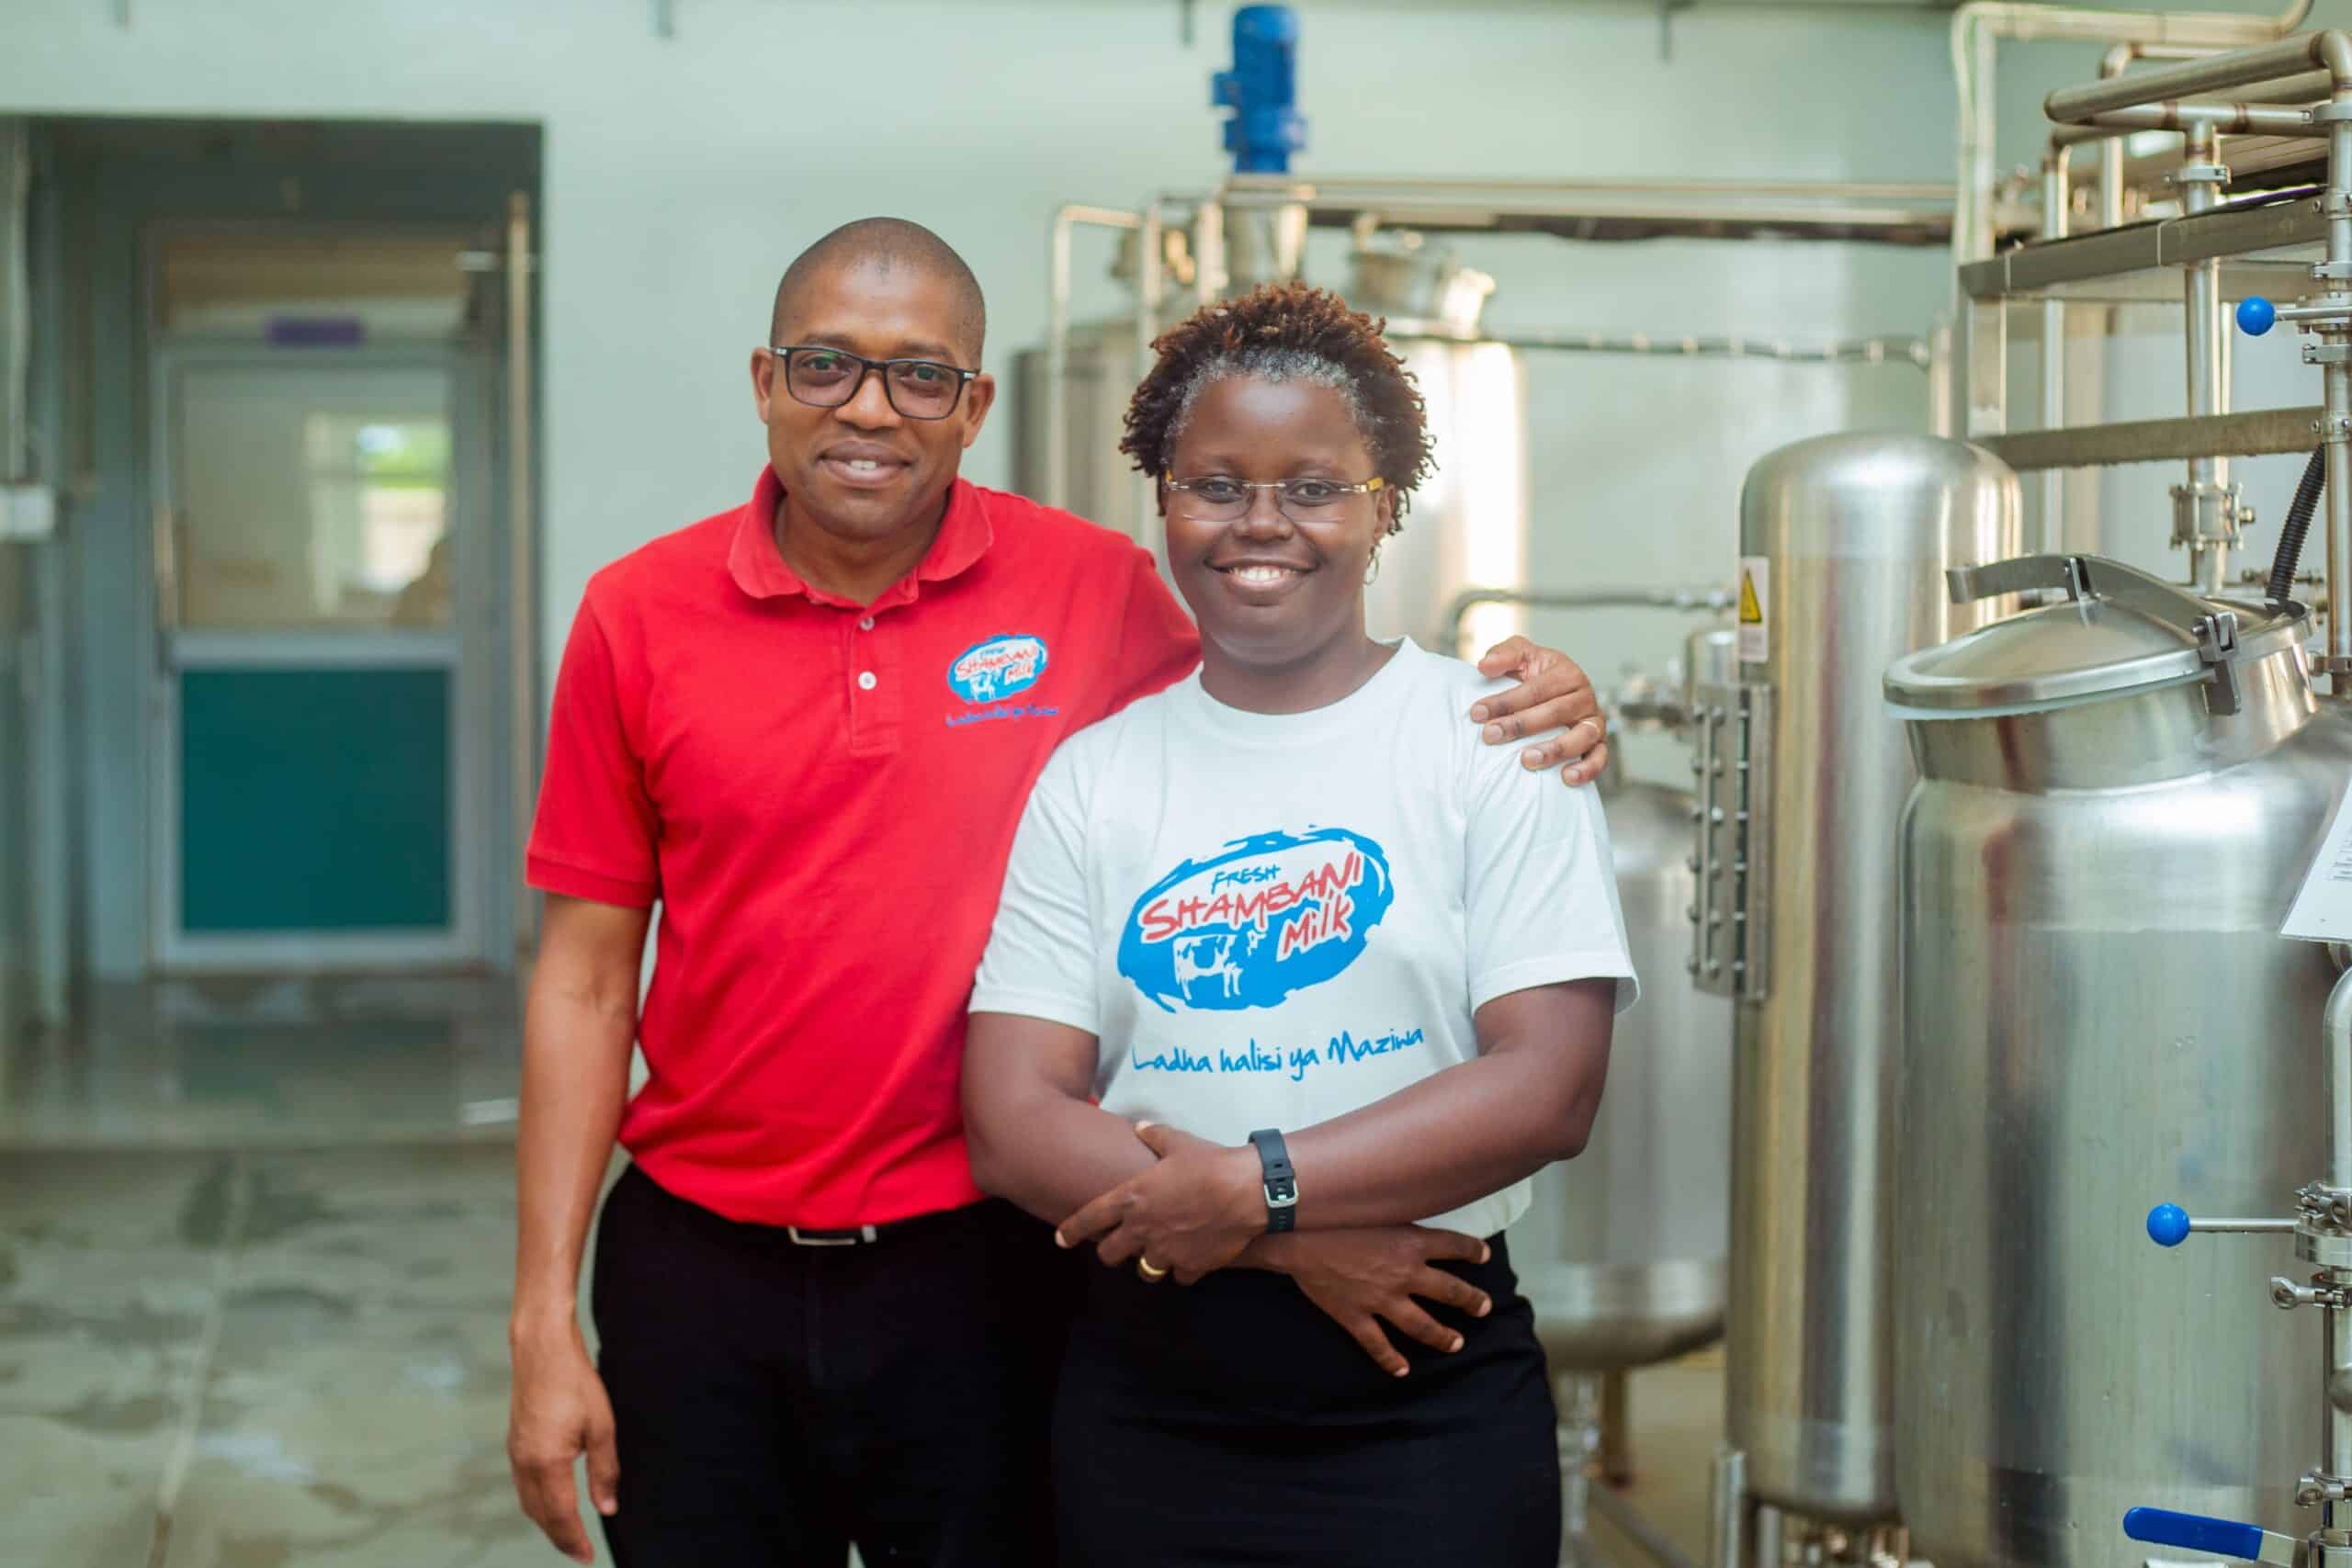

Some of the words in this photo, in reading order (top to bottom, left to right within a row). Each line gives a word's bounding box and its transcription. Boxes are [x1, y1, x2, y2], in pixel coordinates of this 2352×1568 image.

[1142, 852, 1362, 941] SHAMBANI
[1211, 863, 1281, 896] FRESH
[1283, 893, 1351, 953] Milk
[1132, 1043, 1214, 1073] Ladha
[1219, 1037, 1283, 1073] halisi
[1288, 1047, 1320, 1082] ya
[1328, 1028, 1425, 1065] Maziwa
